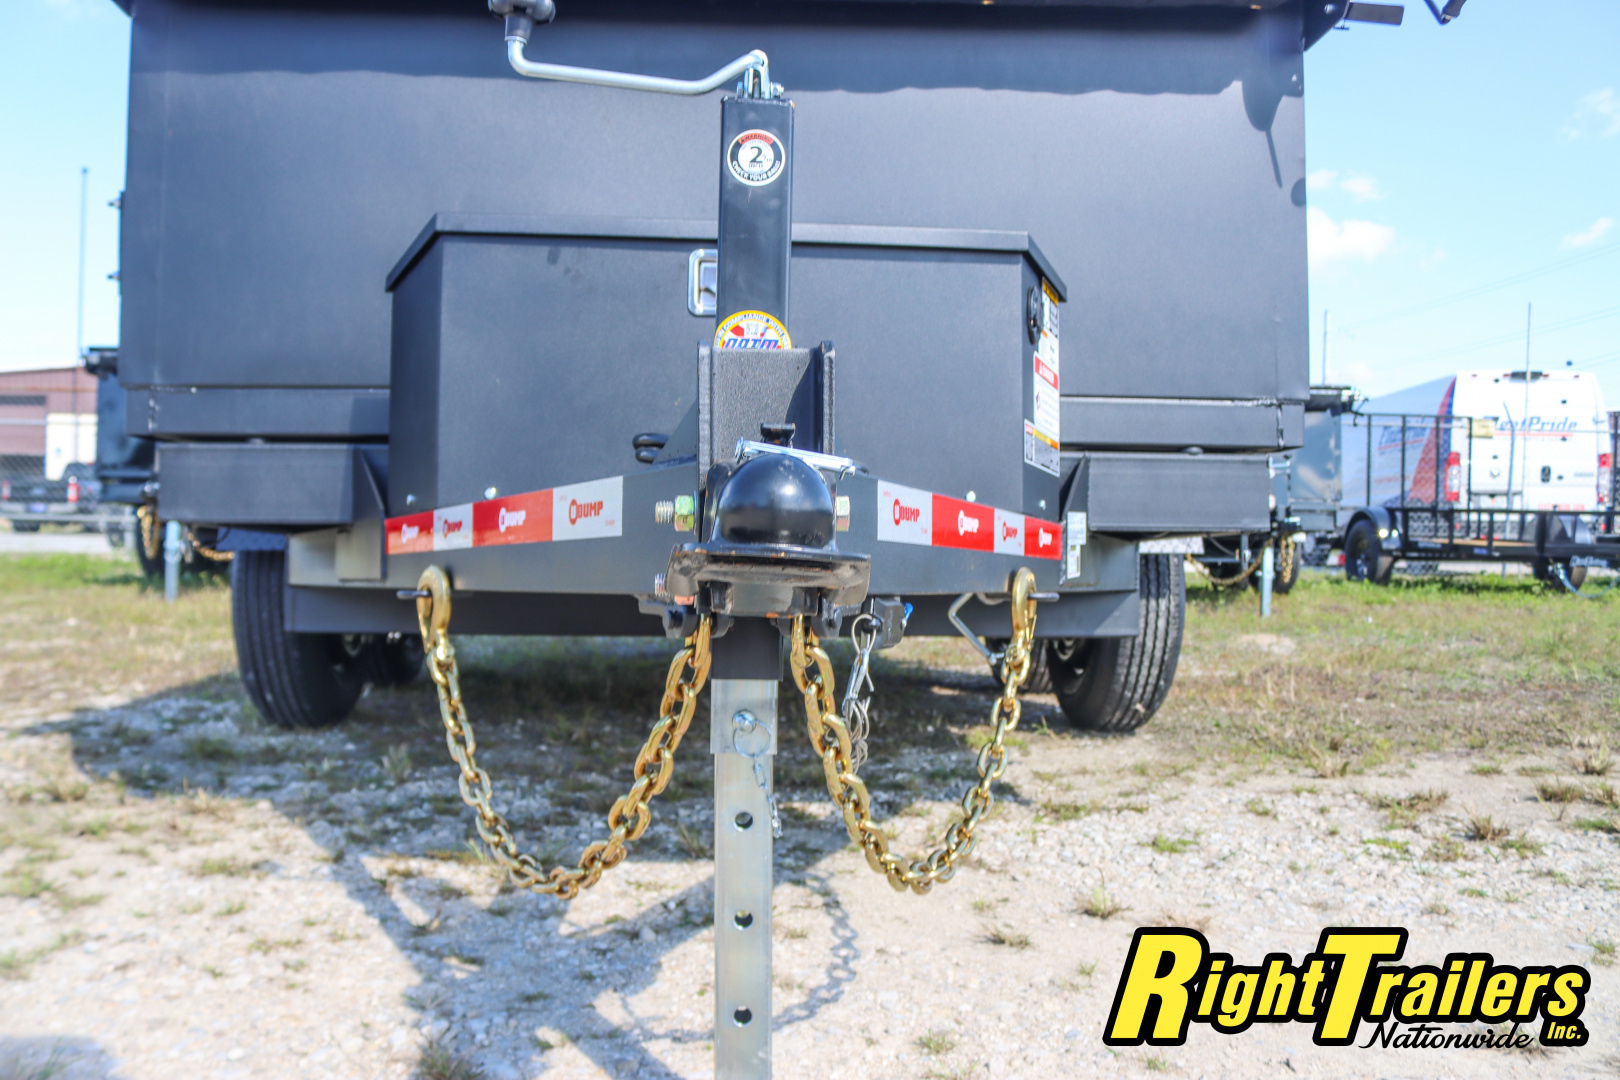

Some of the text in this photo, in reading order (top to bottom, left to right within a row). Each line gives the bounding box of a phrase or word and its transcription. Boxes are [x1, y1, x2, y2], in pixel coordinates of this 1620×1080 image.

[749, 146, 763, 163] 2
[732, 160, 749, 180] CHECK
[749, 172, 768, 182] YOUR
[1484, 416, 1578, 431] leetPride
